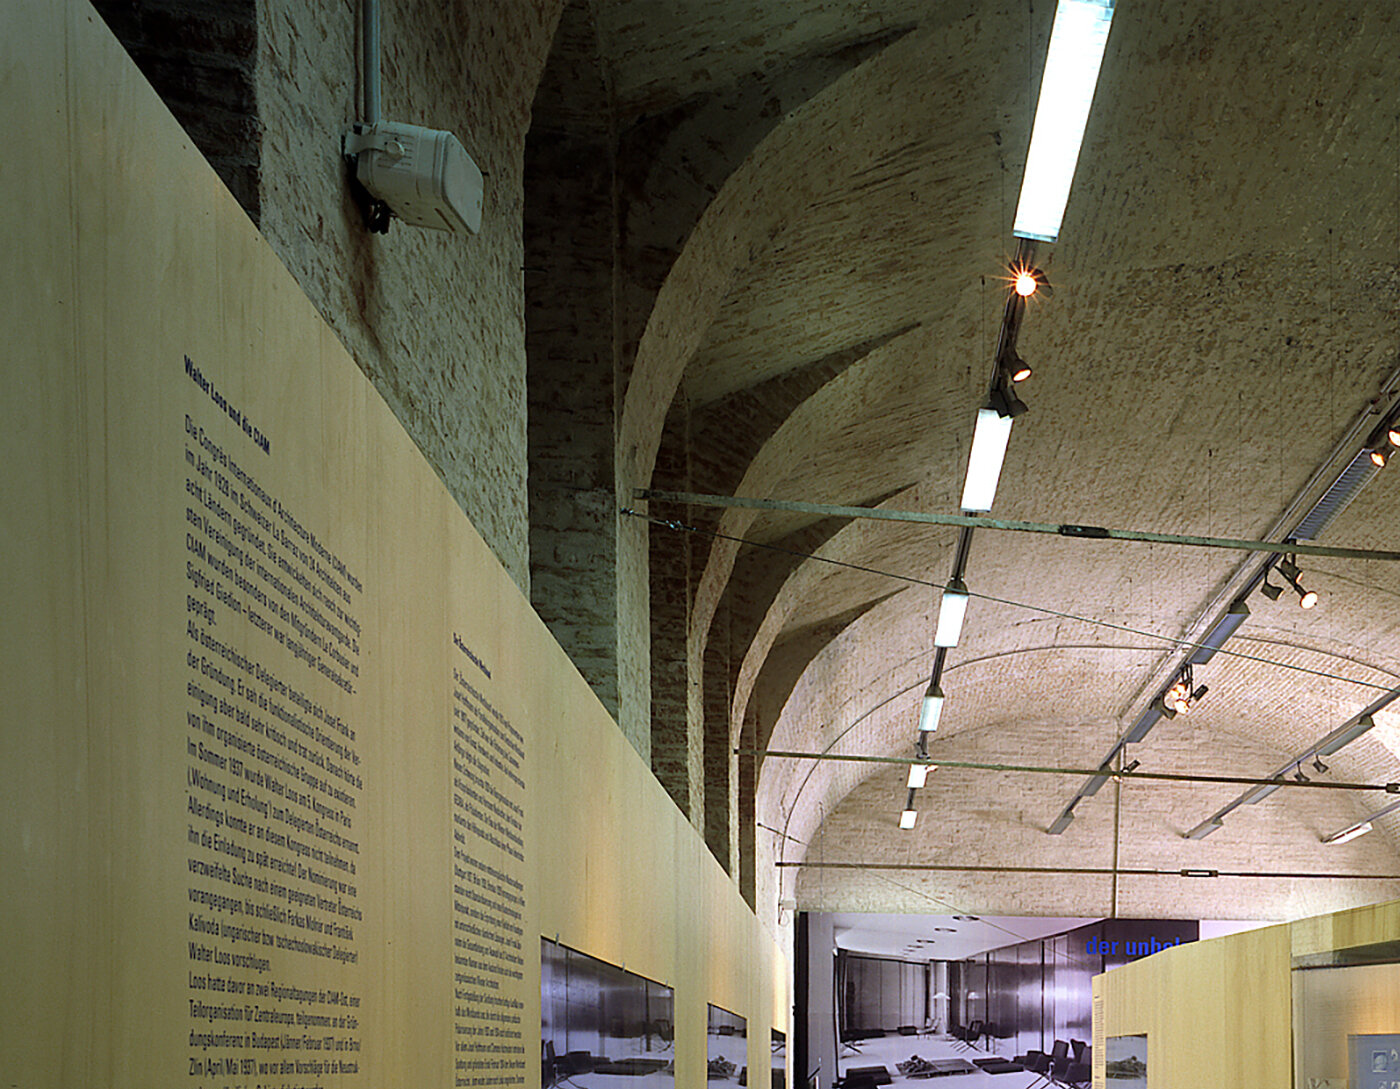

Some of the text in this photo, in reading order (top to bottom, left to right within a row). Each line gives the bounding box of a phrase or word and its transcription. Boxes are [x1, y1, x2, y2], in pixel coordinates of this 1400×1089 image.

[184, 354, 269, 455] Walter Loos und die CIAM
[185, 414, 227, 467] Die Congrès
[196, 454, 212, 481] Jahr
[214, 470, 229, 497] 1928
[186, 478, 231, 526] acht Ländern
[186, 507, 202, 530] sten
[203, 516, 243, 566] Vereinigung
[186, 532, 233, 581] CIAM wurden
[186, 560, 214, 595] Sigfried
[186, 619, 254, 674] Als österreichischer
[187, 651, 199, 669] der
[187, 682, 217, 714] einigung
[219, 697, 235, 718] aber
[187, 711, 255, 757] von ihm organisierte
[198, 741, 227, 769] Sommer
[228, 757, 243, 776] 1937
[227, 789, 239, 803] und
[188, 795, 223, 827] Allerdings
[225, 810, 247, 833] konnte
[188, 824, 199, 844] ihn
[201, 832, 212, 849] die
[213, 833, 246, 864] Einladung
[188, 859, 230, 882] verzweifelte
[189, 913, 219, 936] Kalivoda
[188, 942, 230, 965] Walter Loos
[1085, 935, 1119, 955] der
[189, 971, 206, 990] Loos
[207, 973, 225, 992] hatte
[227, 979, 245, 994] davor
[189, 998, 243, 1023] Teilorganisation
[189, 1028, 243, 1051] dungskonferenz
